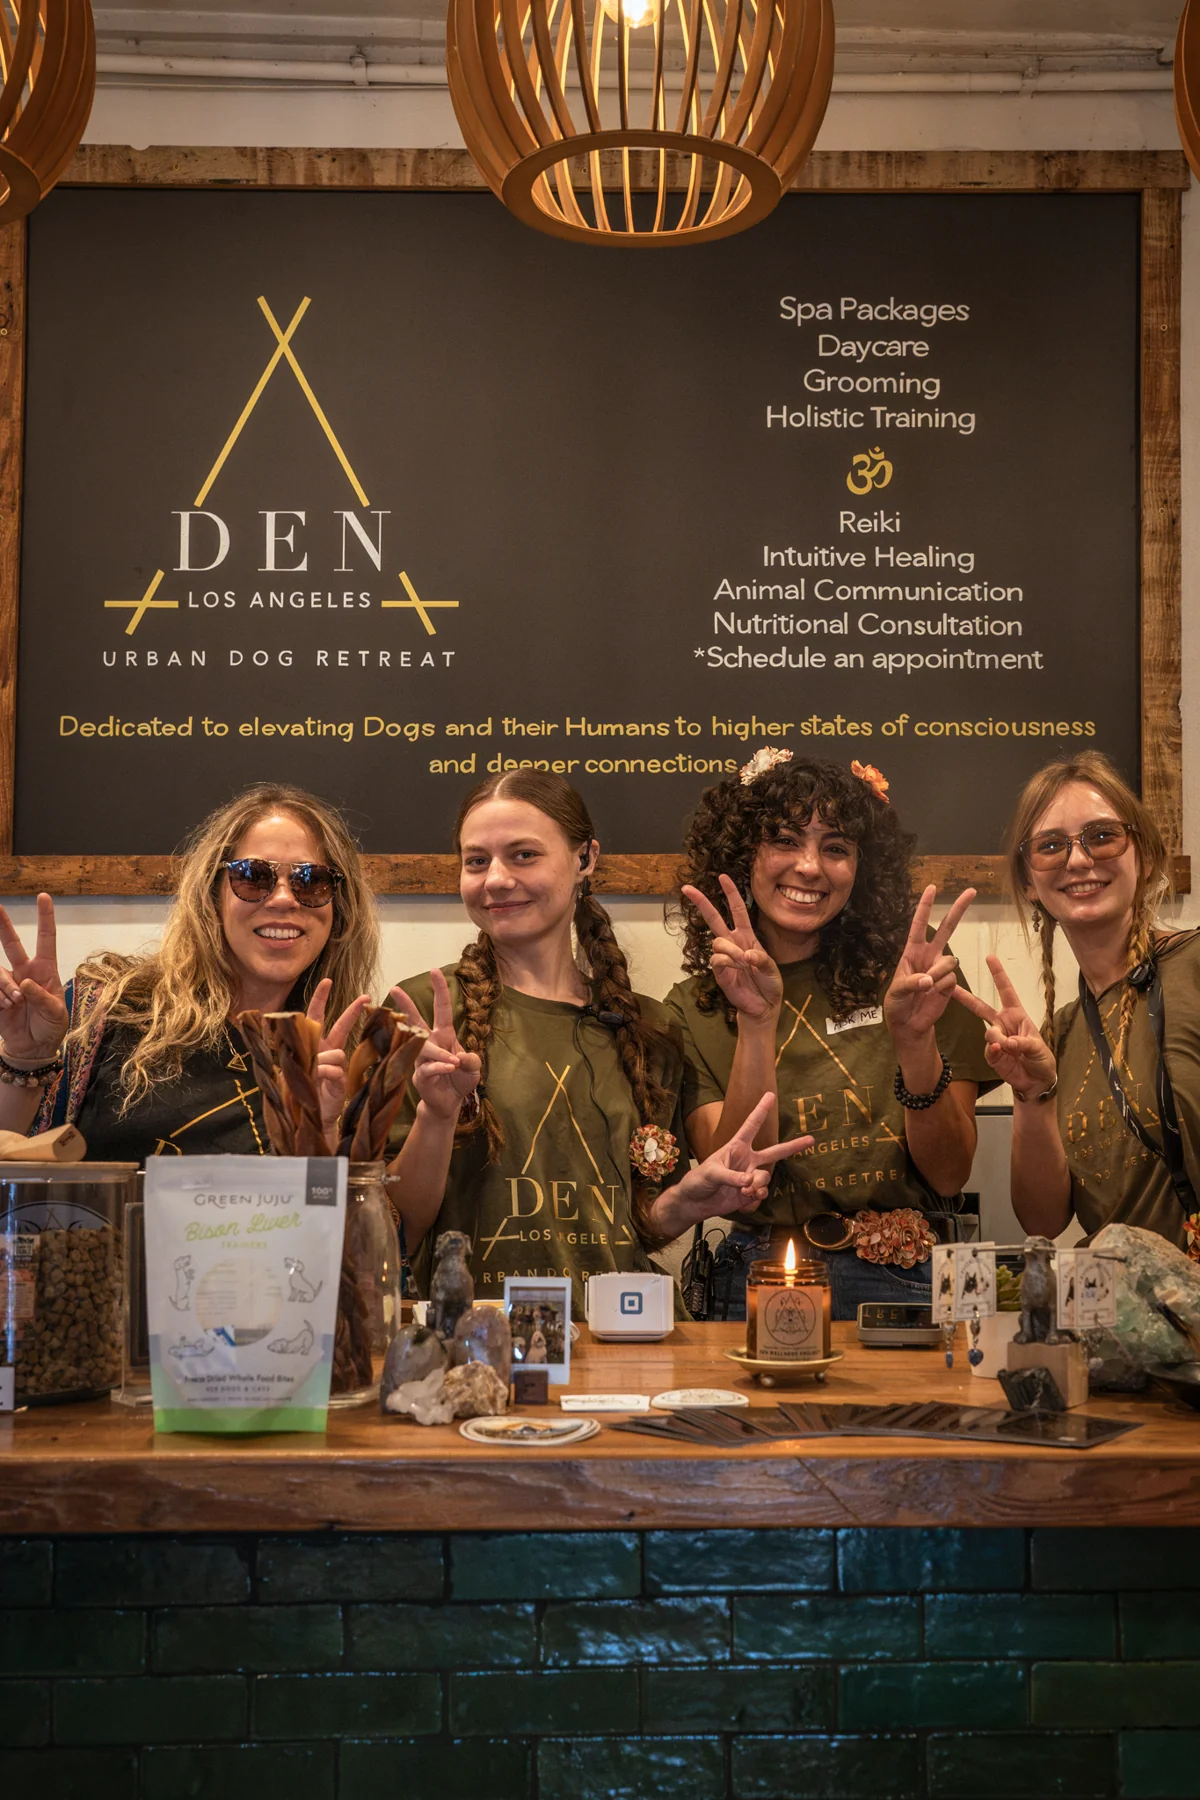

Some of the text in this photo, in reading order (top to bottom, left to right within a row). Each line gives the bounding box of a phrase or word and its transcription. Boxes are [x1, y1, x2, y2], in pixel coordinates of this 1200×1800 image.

[779, 295, 970, 328] Spa Packages
[818, 334, 930, 363] Daycare
[803, 368, 941, 400] Grooming
[766, 404, 976, 435] Holistic Training
[839, 509, 901, 534] Reiki
[171, 510, 391, 573] DEN
[763, 545, 975, 574] Intuitive Healing
[188, 590, 371, 609] LOS ANGELES
[712, 577, 1024, 603] Animal Communication
[713, 611, 1023, 637] Nutritional Consultation
[103, 649, 456, 668] URBAN DOG RETREAT
[833, 652, 865, 670] an
[871, 647, 1044, 675] appointment
[59, 713, 1096, 743] Dedicated to elevating Dogs and their Humans to higher states of consciousness
[429, 752, 738, 774] and deeper connections
[860, 1009, 879, 1022] ME
[791, 1085, 875, 1136] EN
[194, 1193, 292, 1209] GREEN JUJU
[505, 1177, 621, 1225] DEN
[185, 1211, 303, 1242] Bison Liver
[520, 1229, 552, 1242] LOS
